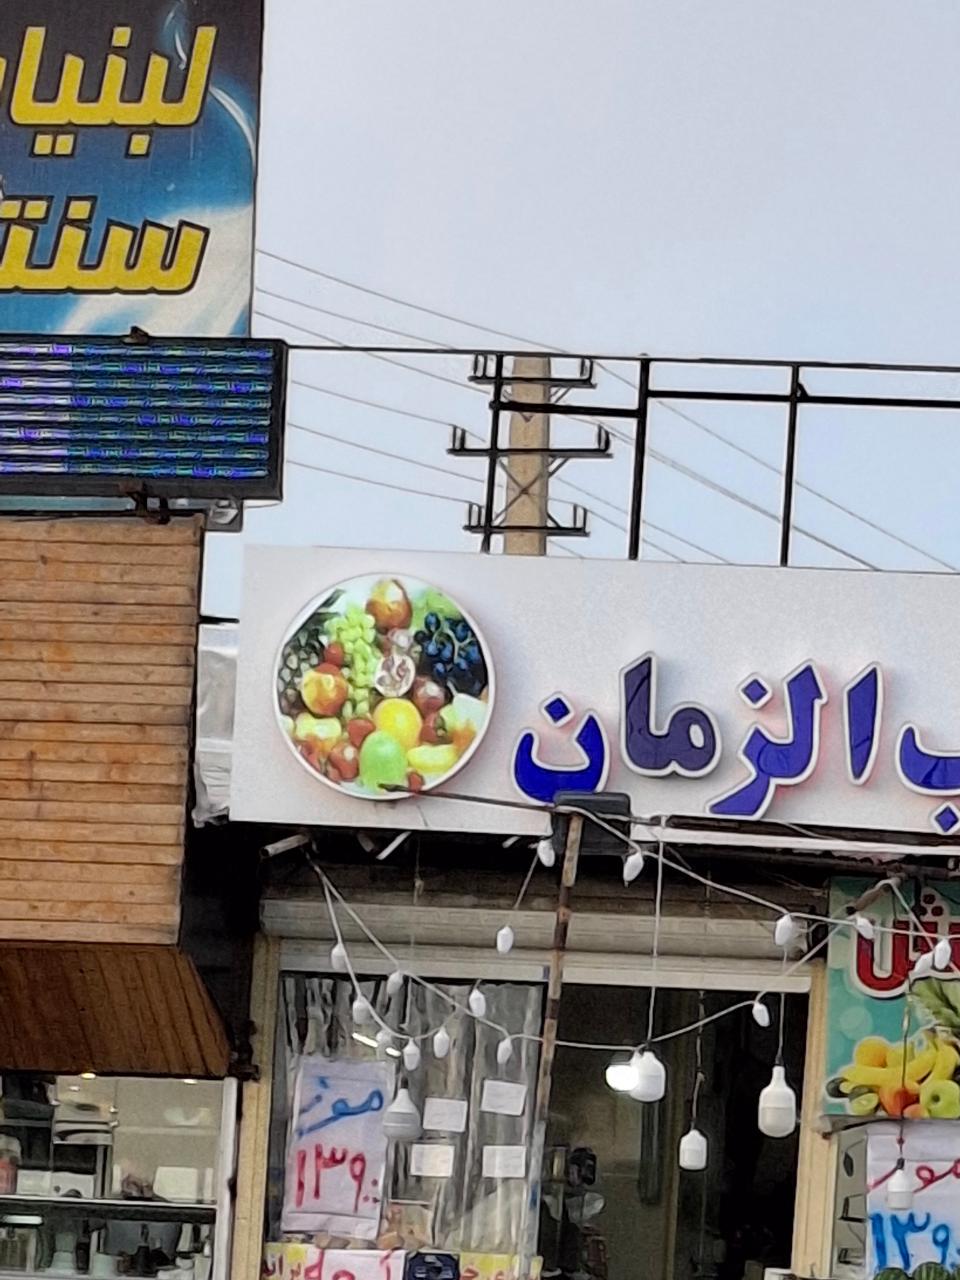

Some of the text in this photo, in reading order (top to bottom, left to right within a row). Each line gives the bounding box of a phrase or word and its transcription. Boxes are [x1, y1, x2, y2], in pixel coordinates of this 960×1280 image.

[0, 25, 219, 158] لبنیا
[0, 195, 211, 294] سنت
[511, 652, 887, 820] الزمان
